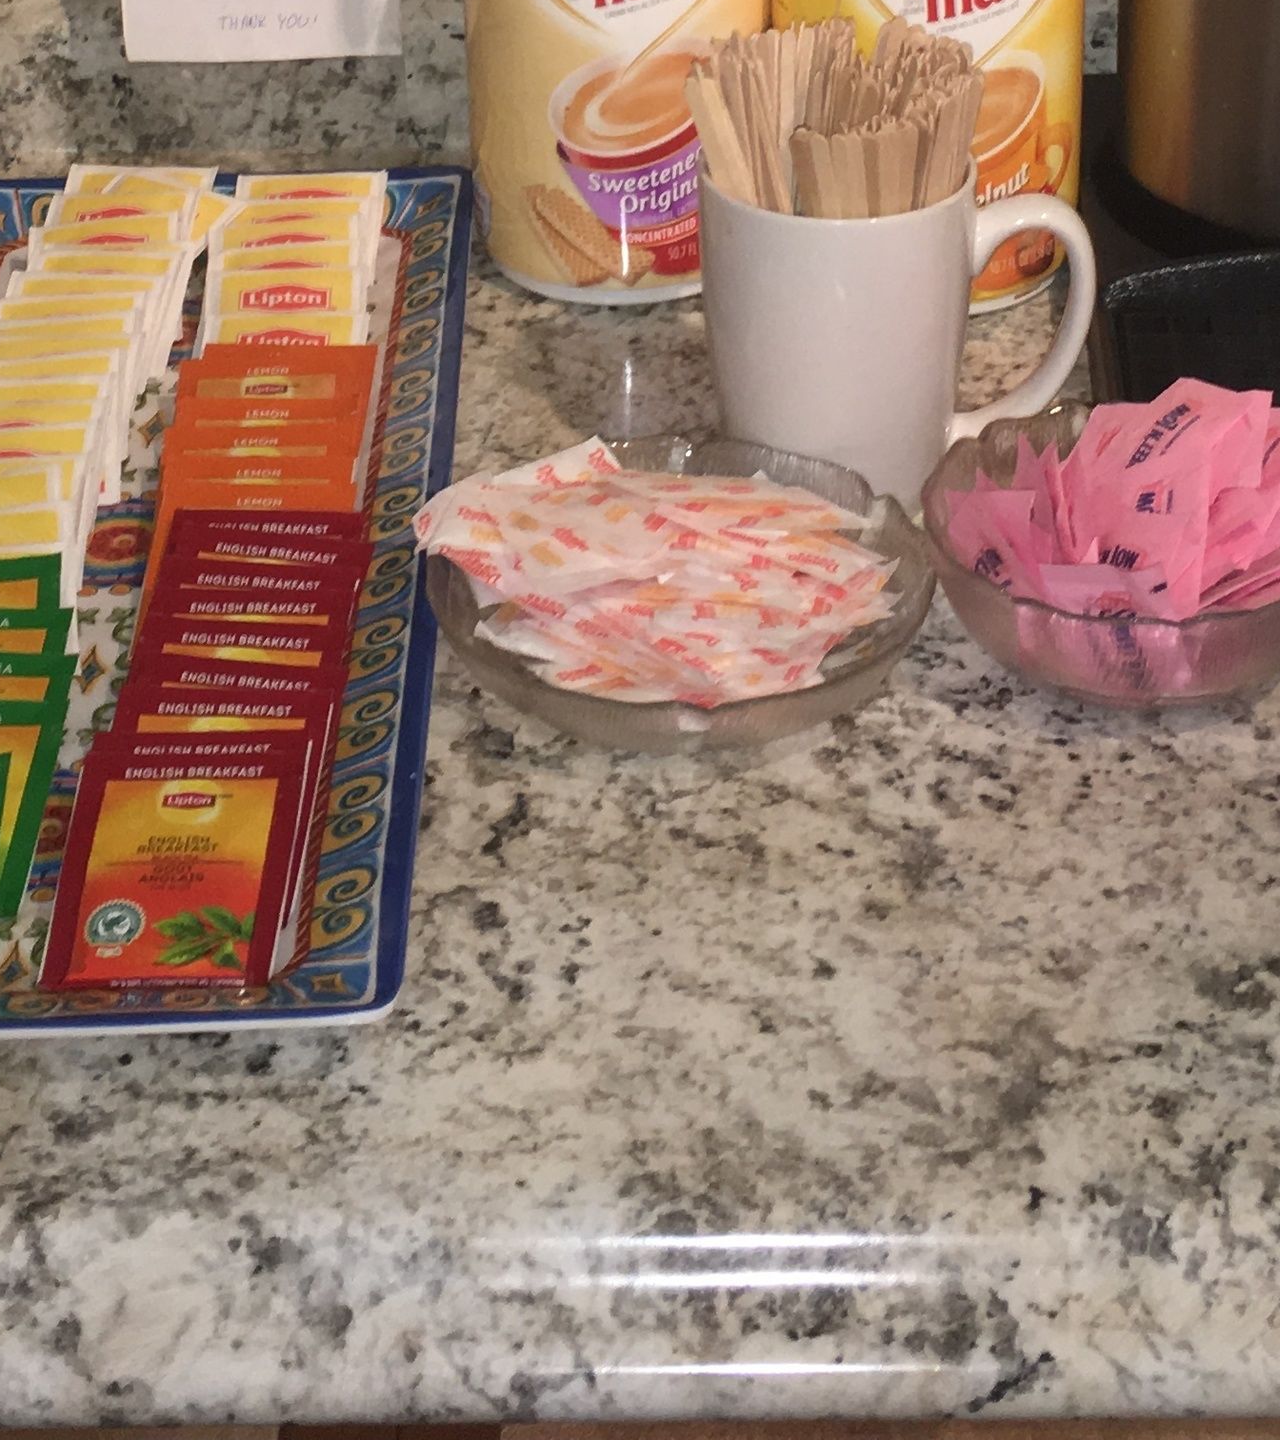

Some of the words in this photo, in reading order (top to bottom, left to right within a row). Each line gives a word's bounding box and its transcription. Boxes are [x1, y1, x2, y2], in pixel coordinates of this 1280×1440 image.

[623, 216, 697, 243] ONCENTRATED
[248, 290, 322, 309] Lipton
[245, 408, 290, 419] LEMON
[234, 437, 279, 448] LEMON
[236, 468, 282, 478] LEMON
[236, 496, 283, 508] LEMON
[262, 522, 329, 536] BREAKFAST
[215, 542, 267, 558] ENGLISH
[269, 545, 338, 566] BREAKFAST
[197, 573, 250, 587] ENGLISH
[252, 575, 321, 592] BREAKFAST
[189, 602, 243, 614] ENGLISH
[246, 602, 317, 614] BREAKFAST
[181, 632, 235, 645] ENGLISH
[238, 634, 310, 650] BREAKFAST
[180, 671, 235, 686] ENGLISH
[237, 674, 312, 691] BREAKFAST
[157, 702, 215, 715] ENGLISH
[218, 704, 293, 717] BREAKFAST
[125, 766, 184, 779] ENGLISH
[187, 765, 265, 779] BREAKFAST
[166, 794, 214, 807] Lipton
